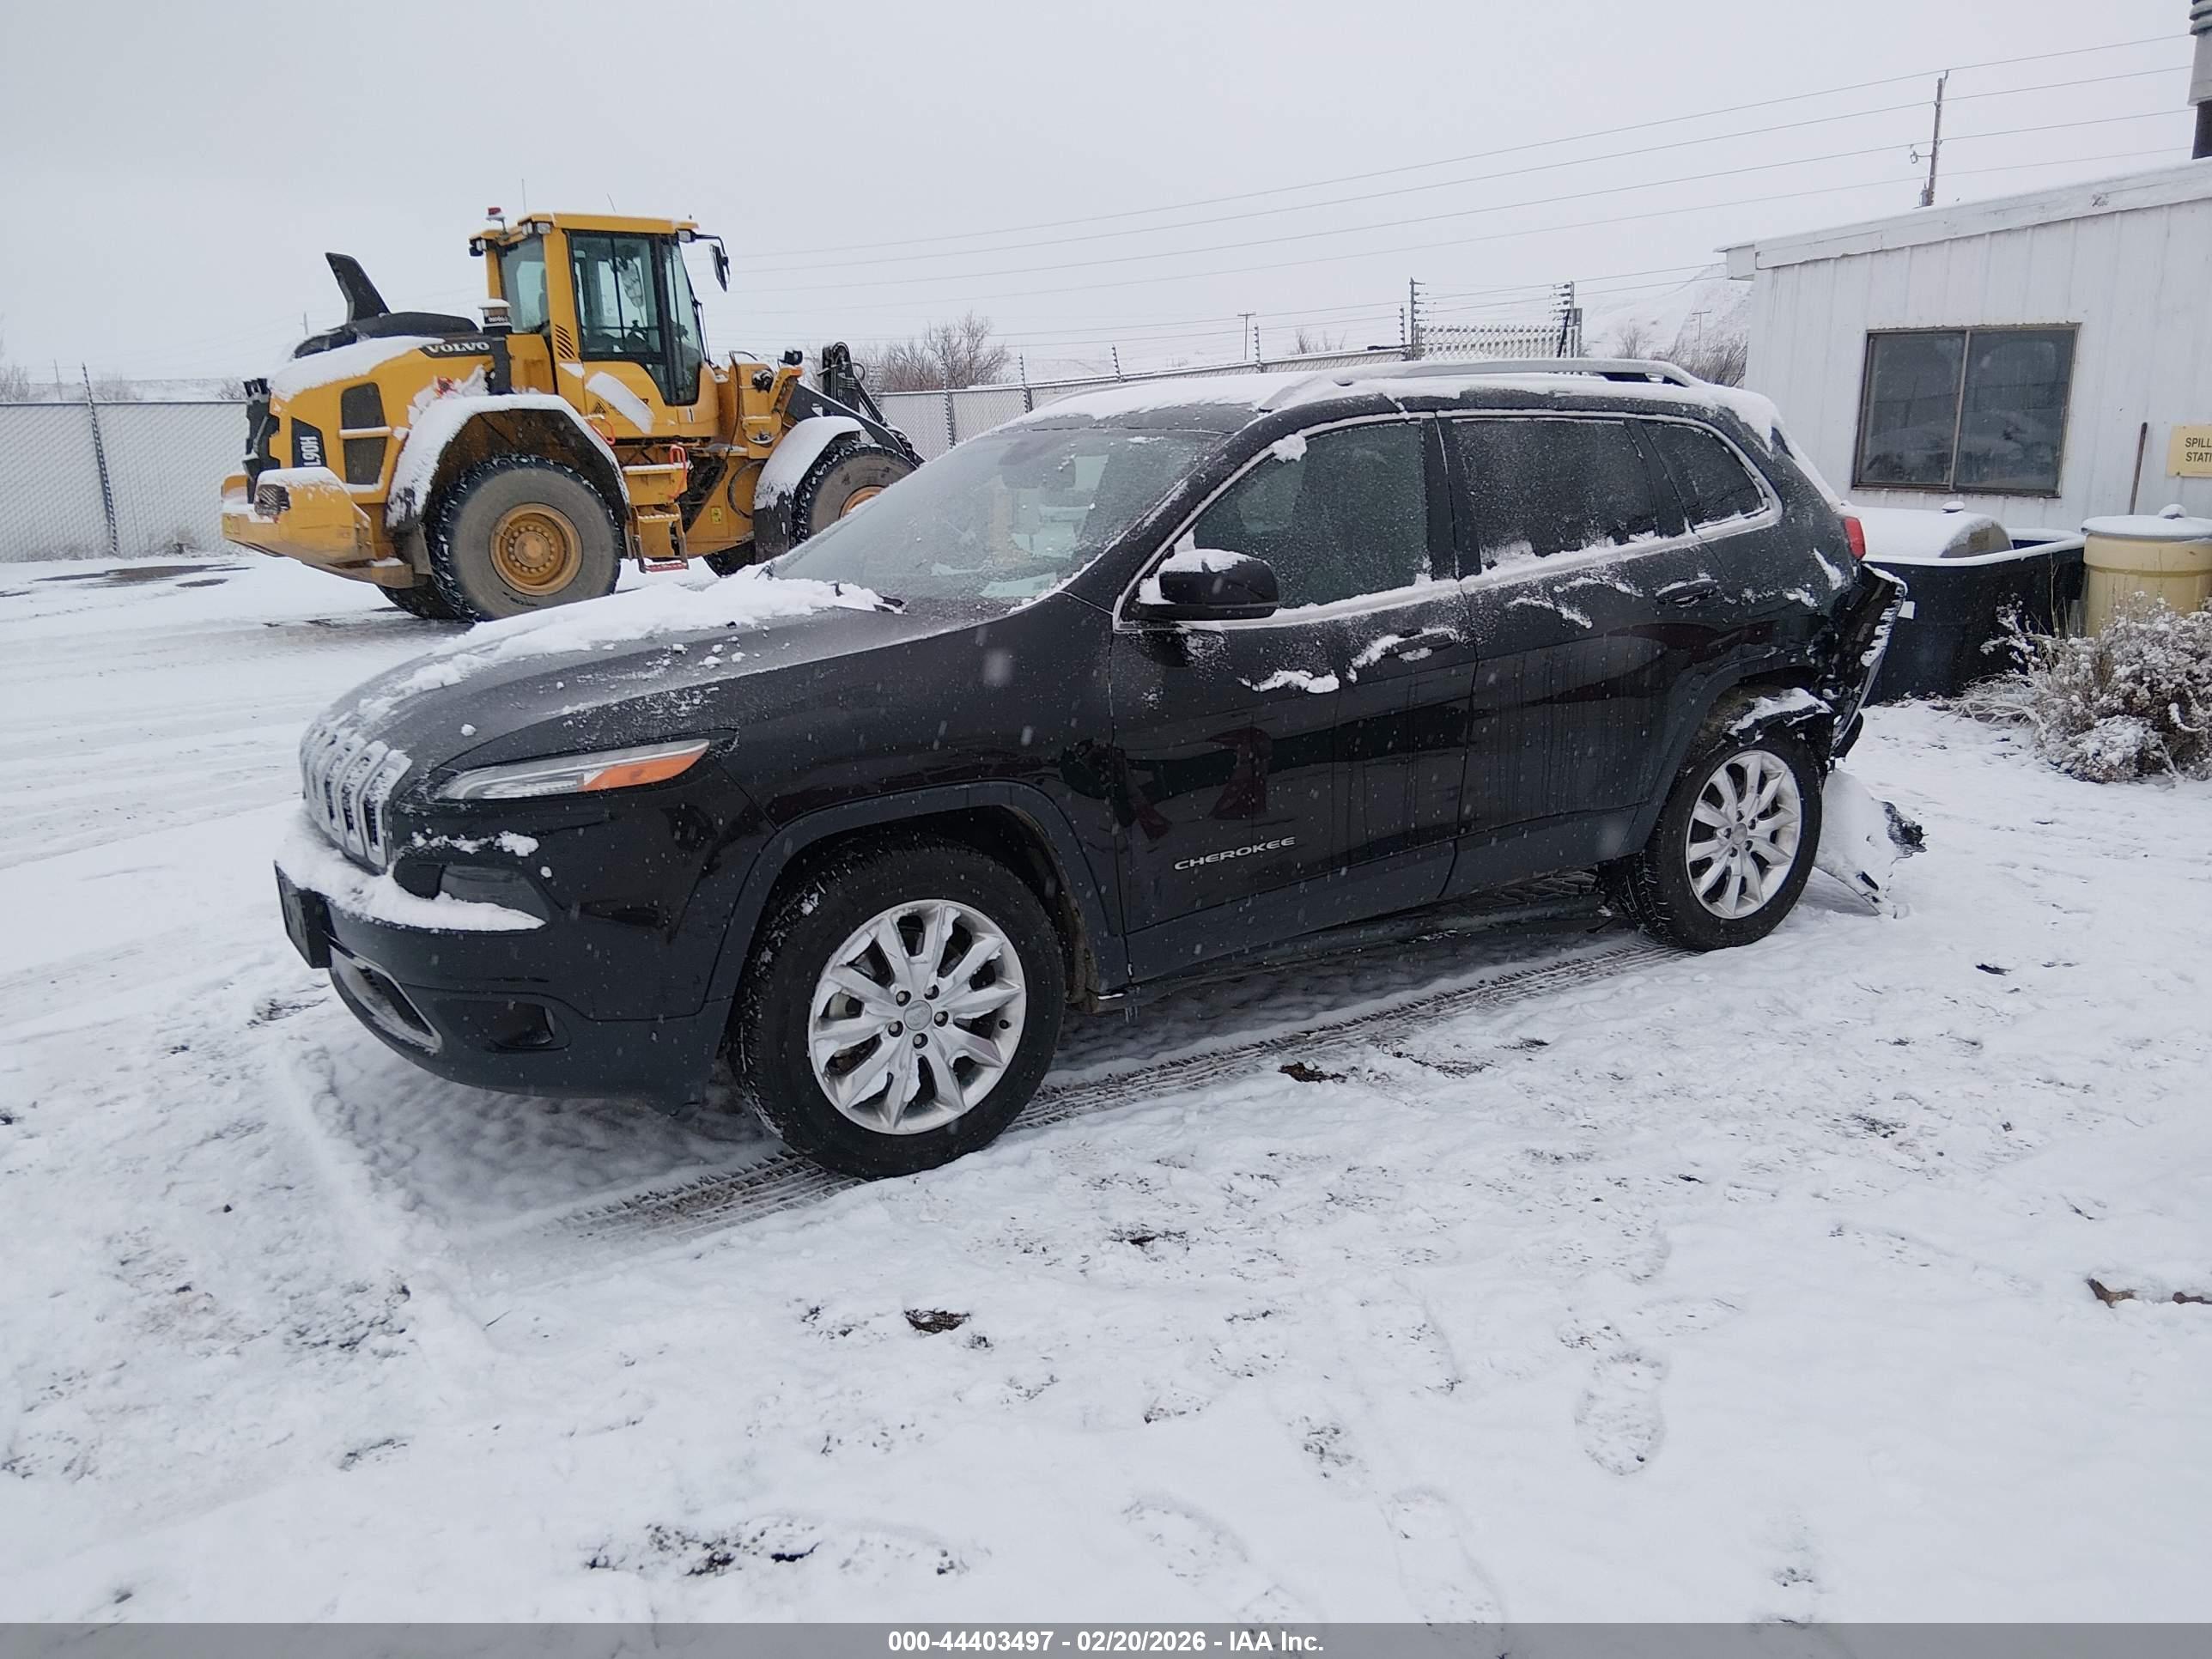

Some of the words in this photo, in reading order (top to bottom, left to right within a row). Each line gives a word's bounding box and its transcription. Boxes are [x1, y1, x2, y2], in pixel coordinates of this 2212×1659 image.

[426, 342, 490, 353] VOLVO
[299, 436, 322, 466] L90H
[2185, 437, 2212, 447] SPILL
[1174, 836, 1296, 870] CHEROKEE
